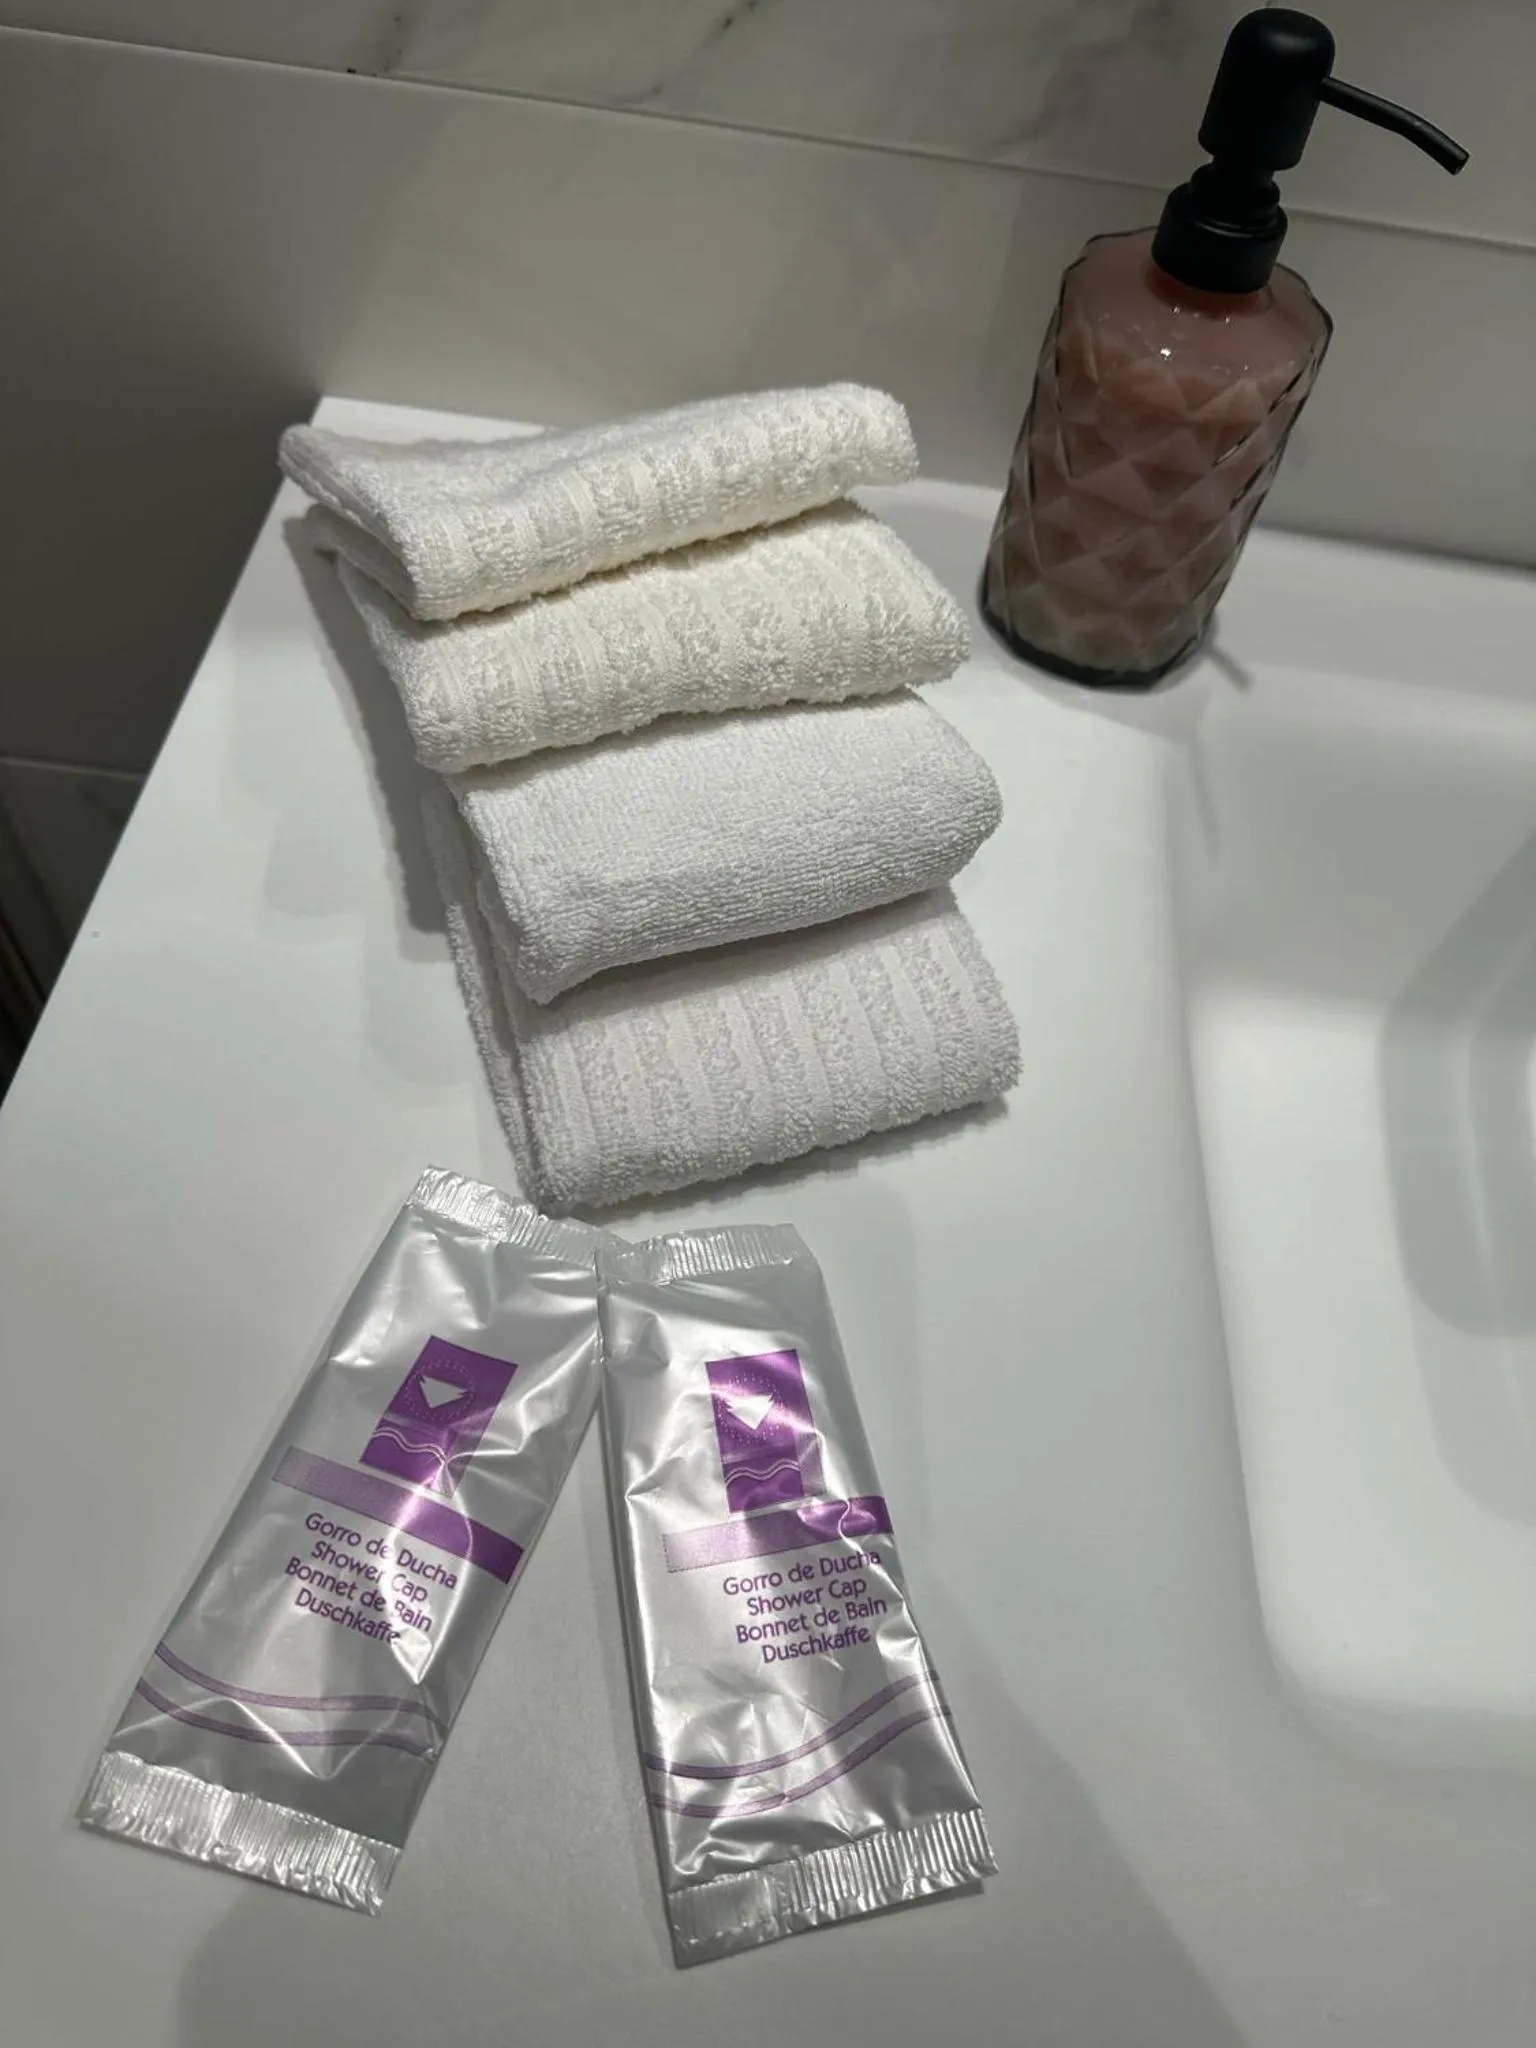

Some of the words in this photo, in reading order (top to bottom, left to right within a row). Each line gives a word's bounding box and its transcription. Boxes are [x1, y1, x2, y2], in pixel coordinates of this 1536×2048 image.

[305, 1512, 361, 1547] Gorro
[396, 1549, 458, 1589] Ducha
[311, 1541, 383, 1583] Shower
[392, 1574, 428, 1603] Cap
[723, 1572, 782, 1596] Gorro
[788, 1563, 814, 1582] de
[819, 1549, 881, 1577] Ducha
[285, 1557, 358, 1600] Bonnet
[361, 1588, 385, 1611] de
[747, 1587, 823, 1616] Shower
[828, 1578, 867, 1599] Cap
[295, 1588, 400, 1644] Duschkaffe
[736, 1615, 808, 1644] Bonnet
[814, 1608, 840, 1627] de
[845, 1597, 887, 1621] Bain
[761, 1625, 871, 1664] Duschkaffe
